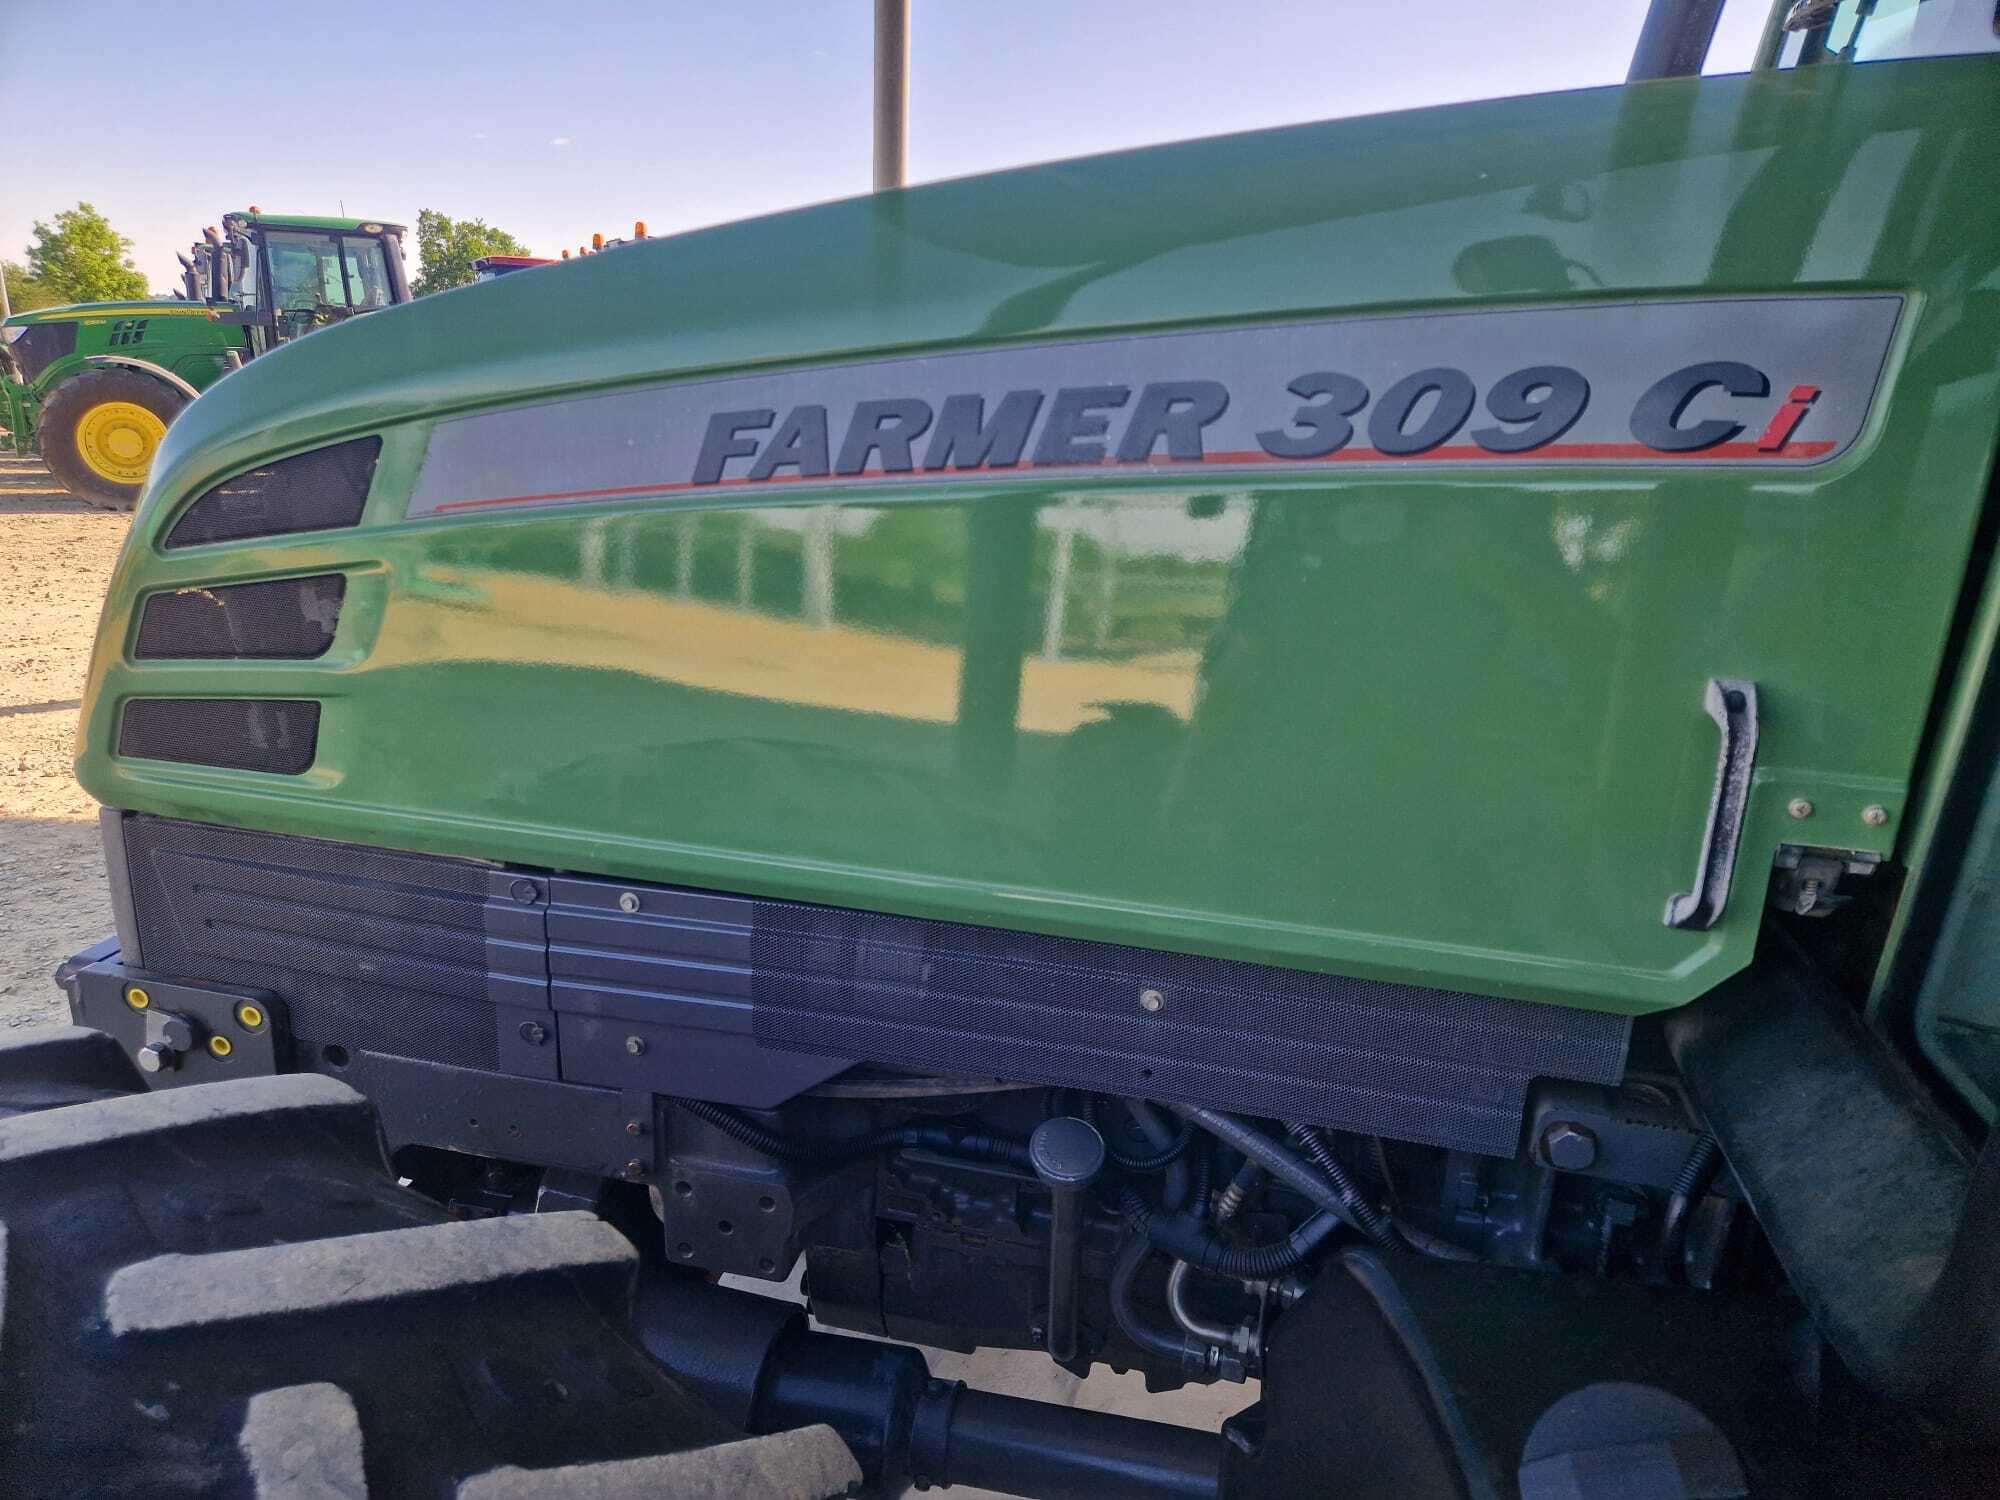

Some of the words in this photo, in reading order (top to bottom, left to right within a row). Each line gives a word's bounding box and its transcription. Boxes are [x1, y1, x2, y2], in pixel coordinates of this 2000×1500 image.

[692, 380, 1230, 485] FARMER
[1255, 365, 1591, 459] 309
[1629, 361, 1822, 452] Ci
